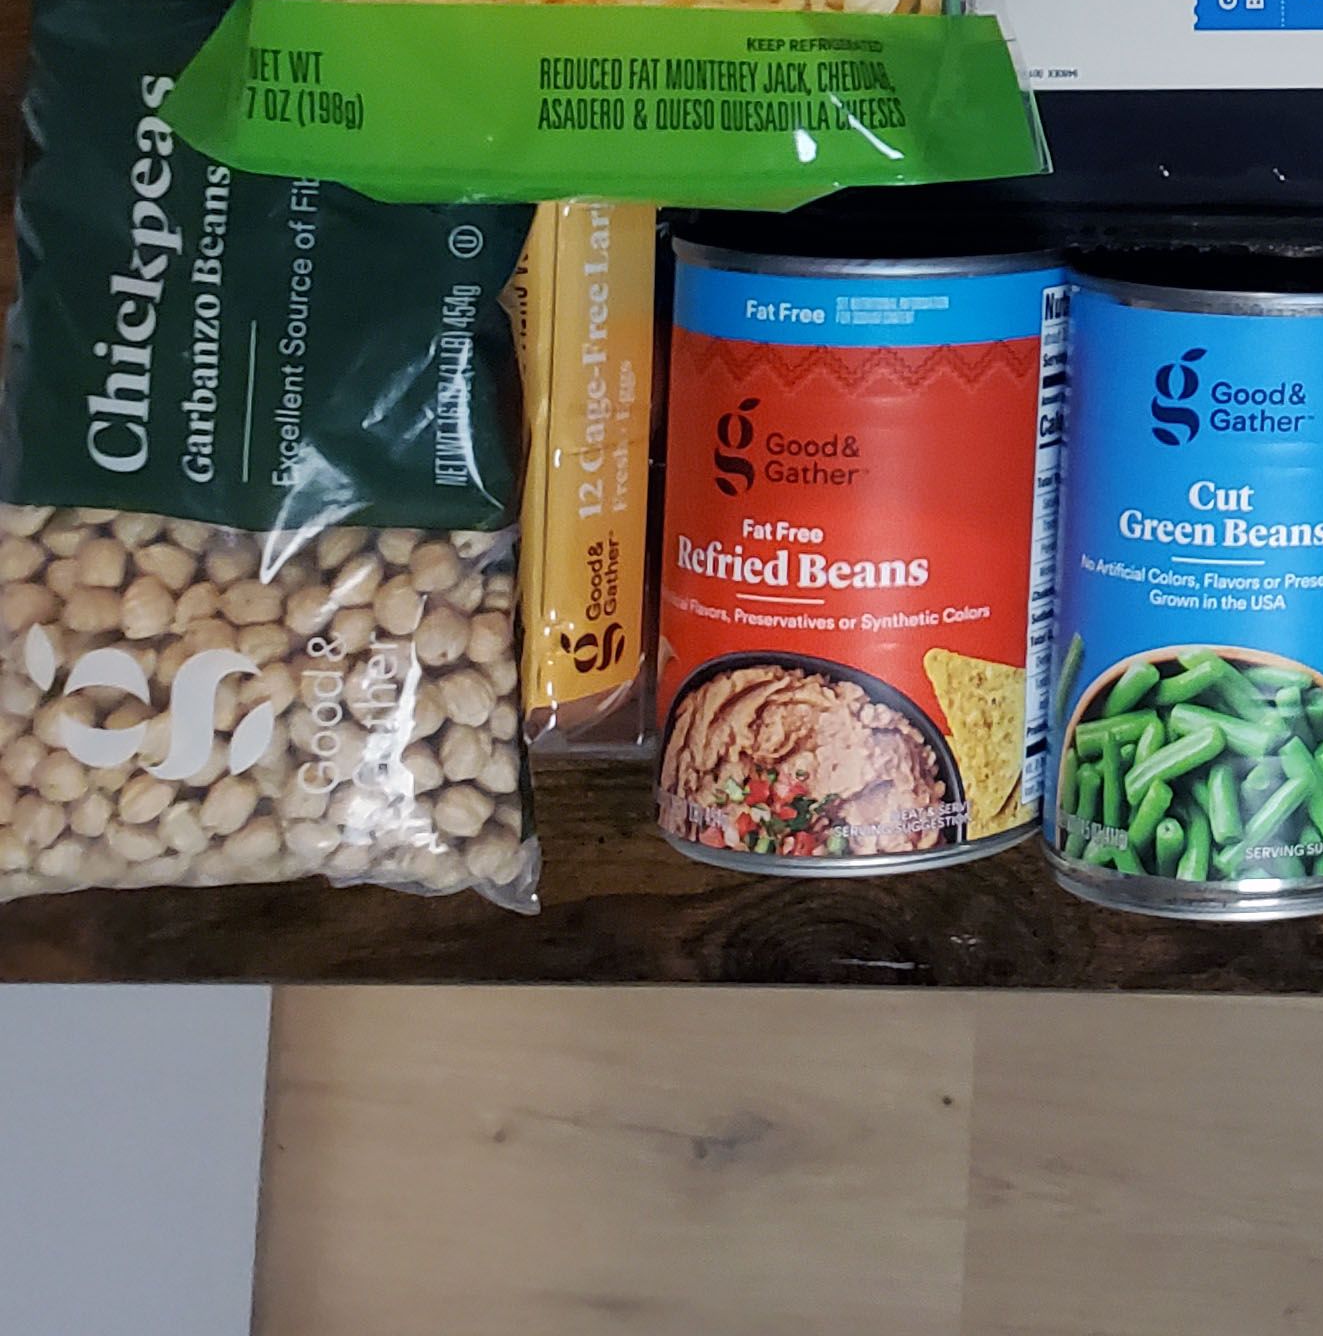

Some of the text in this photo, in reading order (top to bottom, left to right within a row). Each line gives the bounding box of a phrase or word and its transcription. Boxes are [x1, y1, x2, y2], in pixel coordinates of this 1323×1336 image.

[287, 50, 324, 85] WT
[539, 57, 760, 93] REDUCED FAT MONTEREY
[263, 87, 365, 131] OZ (198g)
[537, 97, 716, 131] ASADERO & QUESO
[86, 73, 184, 474] Chickpeas
[181, 163, 232, 485] Garbanzo Beans
[441, 283, 482, 330] 454g
[745, 299, 776, 323] Fat
[778, 301, 826, 325] Free
[272, 218, 316, 489] Excellent Source of
[1210, 380, 1308, 407] Good&
[579, 477, 602, 520] 12
[1187, 479, 1256, 513] Cut
[741, 517, 825, 544] Fat Free
[1118, 509, 1217, 548] Green
[677, 534, 930, 590] Refried Beans
[1203, 572, 1262, 591] Flavors
[1148, 589, 1287, 611] Grown in the USA
[734, 607, 940, 634] Preservatives or Synthetic
[299, 635, 345, 794] Good &
